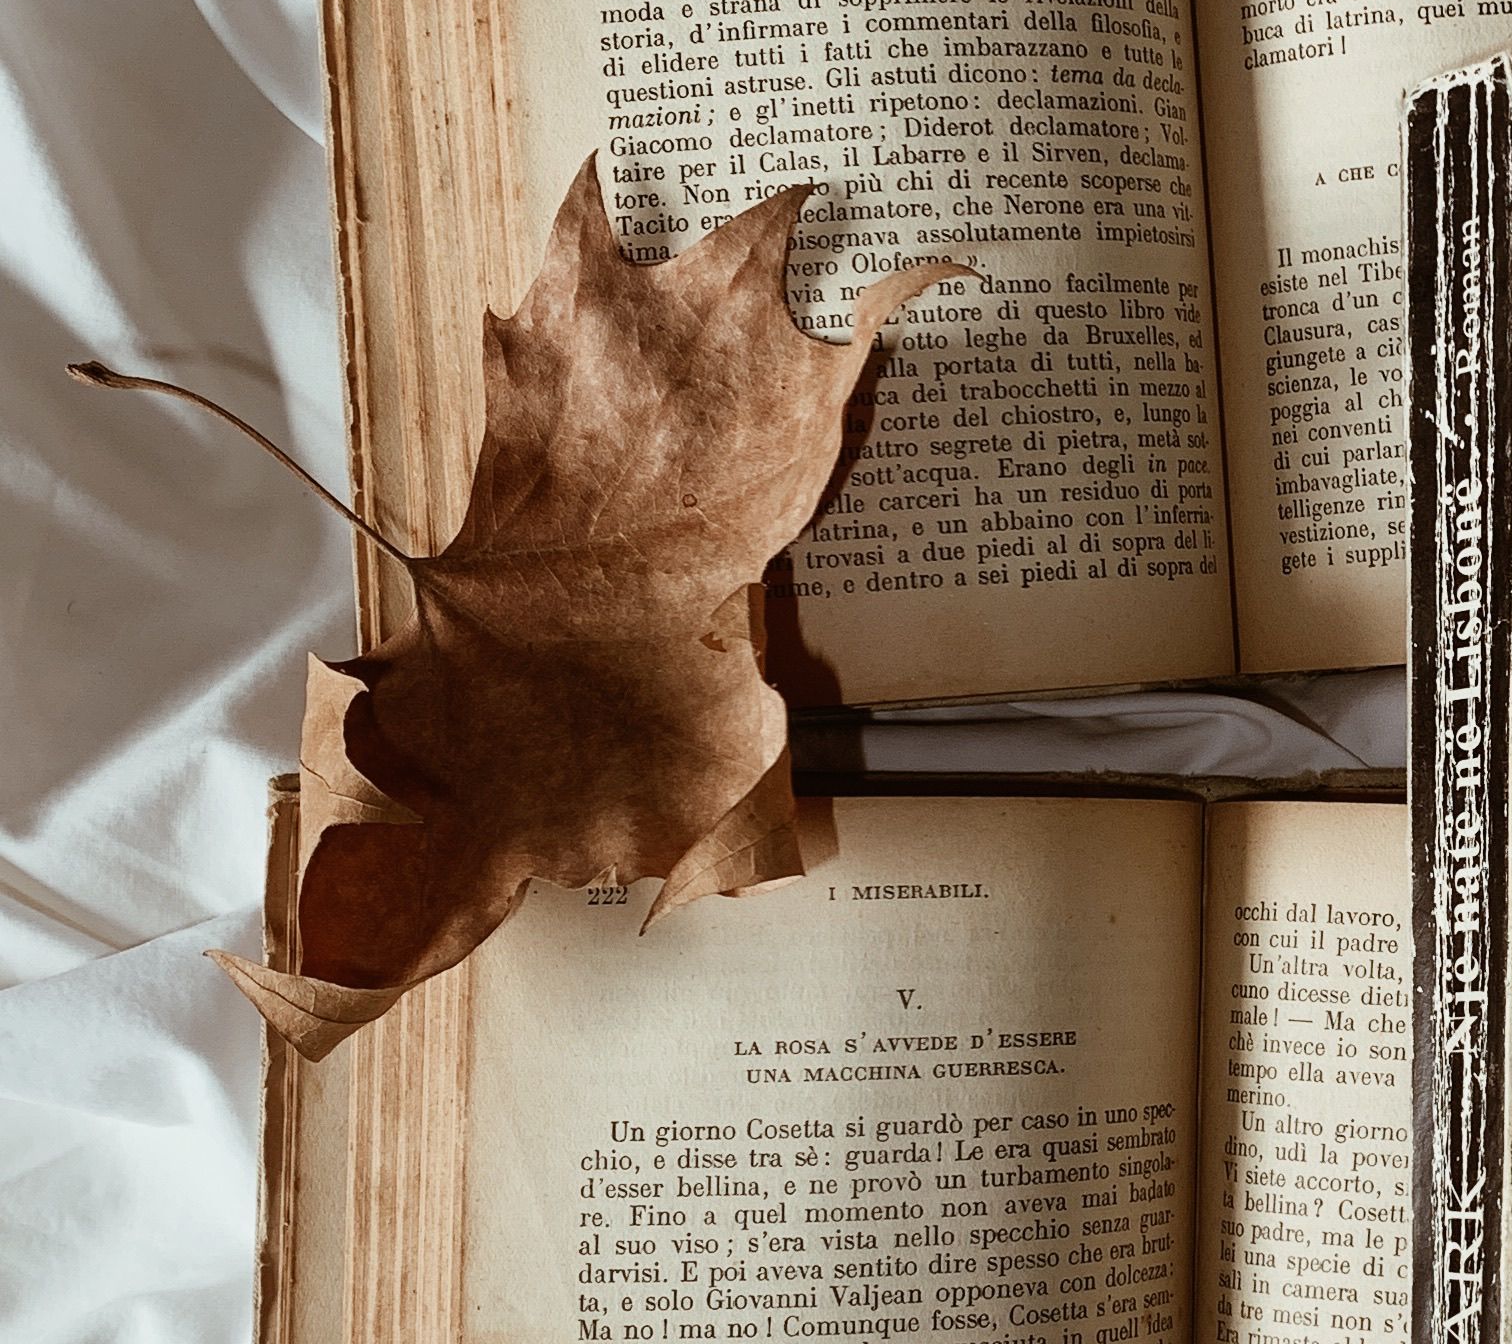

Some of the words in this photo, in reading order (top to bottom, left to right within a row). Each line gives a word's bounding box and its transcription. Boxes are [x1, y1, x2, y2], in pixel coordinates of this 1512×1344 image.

[1240, 25, 1283, 45] buca
[1295, 14, 1313, 33] di
[1326, 7, 1403, 29] latrina,
[1316, 173, 1326, 185] A
[1339, 166, 1374, 181] CHE
[1278, 248, 1292, 267] Il
[1301, 238, 1398, 263] monachis
[1455, 216, 1481, 380] Roman
[1265, 324, 1351, 345] Clausura,
[1368, 318, 1401, 333] cas
[1273, 425, 1298, 445] nei
[1309, 415, 1391, 441] conventi
[1276, 468, 1403, 496] imbavagliate,
[844, 580, 855, 593] e
[867, 572, 943, 591] dentro
[955, 573, 967, 586] a
[979, 564, 1009, 584] sei
[1021, 560, 1077, 588] piedi
[1089, 559, 1107, 578] al
[1118, 557, 1137, 577] di
[1148, 561, 1193, 580] sopra
[588, 887, 627, 905] 222
[829, 888, 835, 900] I
[852, 884, 988, 899] MISERABILI.
[1235, 902, 1277, 920] occhi
[1287, 903, 1315, 922] dal
[1327, 905, 1401, 931] lavoro,
[1234, 931, 1260, 948] con
[1270, 930, 1297, 948] cui
[1311, 931, 1323, 949] il
[1337, 933, 1398, 956] padre
[896, 989, 921, 1009] V.
[735, 1042, 762, 1055] LA
[775, 1041, 830, 1054] ROSA
[747, 1069, 791, 1083] UNA
[804, 1065, 921, 1081] MACCHINA
[933, 1060, 1064, 1078] GUERRESCA.
[1227, 1086, 1289, 1107] merino.
[611, 1121, 645, 1142] Un
[656, 1121, 735, 1147] giorno
[747, 1119, 834, 1139] Cosetta
[846, 1116, 865, 1137] si
[876, 1113, 962, 1142] guardò
[973, 1117, 1013, 1138] per
[1022, 1114, 1069, 1130] caso
[1077, 1106, 1097, 1126] in
[1104, 1108, 1137, 1125] uno
[1144, 1103, 1175, 1125] spec-
[581, 1178, 663, 1198] d'esser
[677, 1176, 767, 1199] bellina,
[785, 1181, 796, 1195] e
[809, 1180, 837, 1194] ne
[850, 1171, 921, 1199] provò
[936, 1175, 966, 1189] un
[981, 1163, 1109, 1187] turbamento
[1119, 1151, 1175, 1179] singola-
